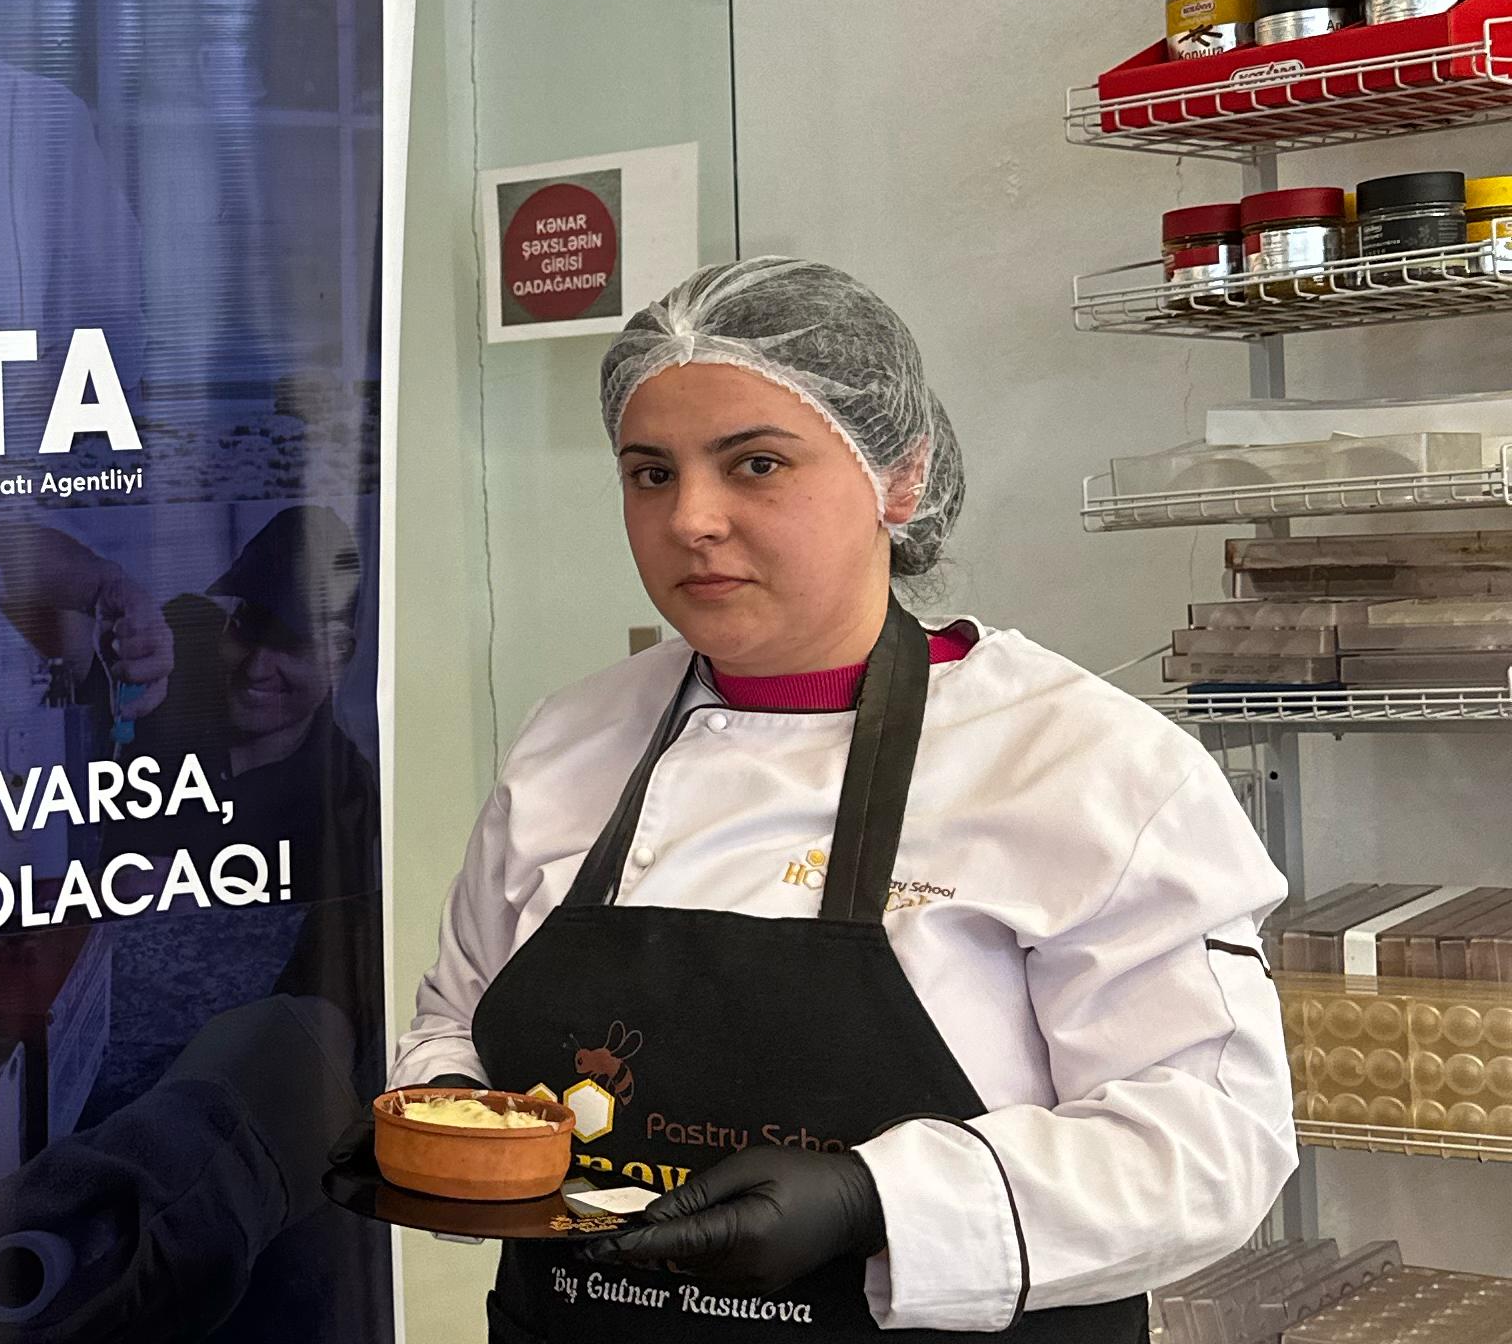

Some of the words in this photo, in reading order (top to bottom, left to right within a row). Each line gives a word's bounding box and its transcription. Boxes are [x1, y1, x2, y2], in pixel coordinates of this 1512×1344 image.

[536, 214, 587, 235] KƏNAR
[521, 232, 603, 259] ŞƏXSLƏRİN
[513, 273, 607, 296] QADAĞANDIR
[40, 468, 144, 496] Agentliyi
[910, 882, 956, 899] School
[646, 1112, 749, 1152] Pastry
[551, 1266, 578, 1303] By
